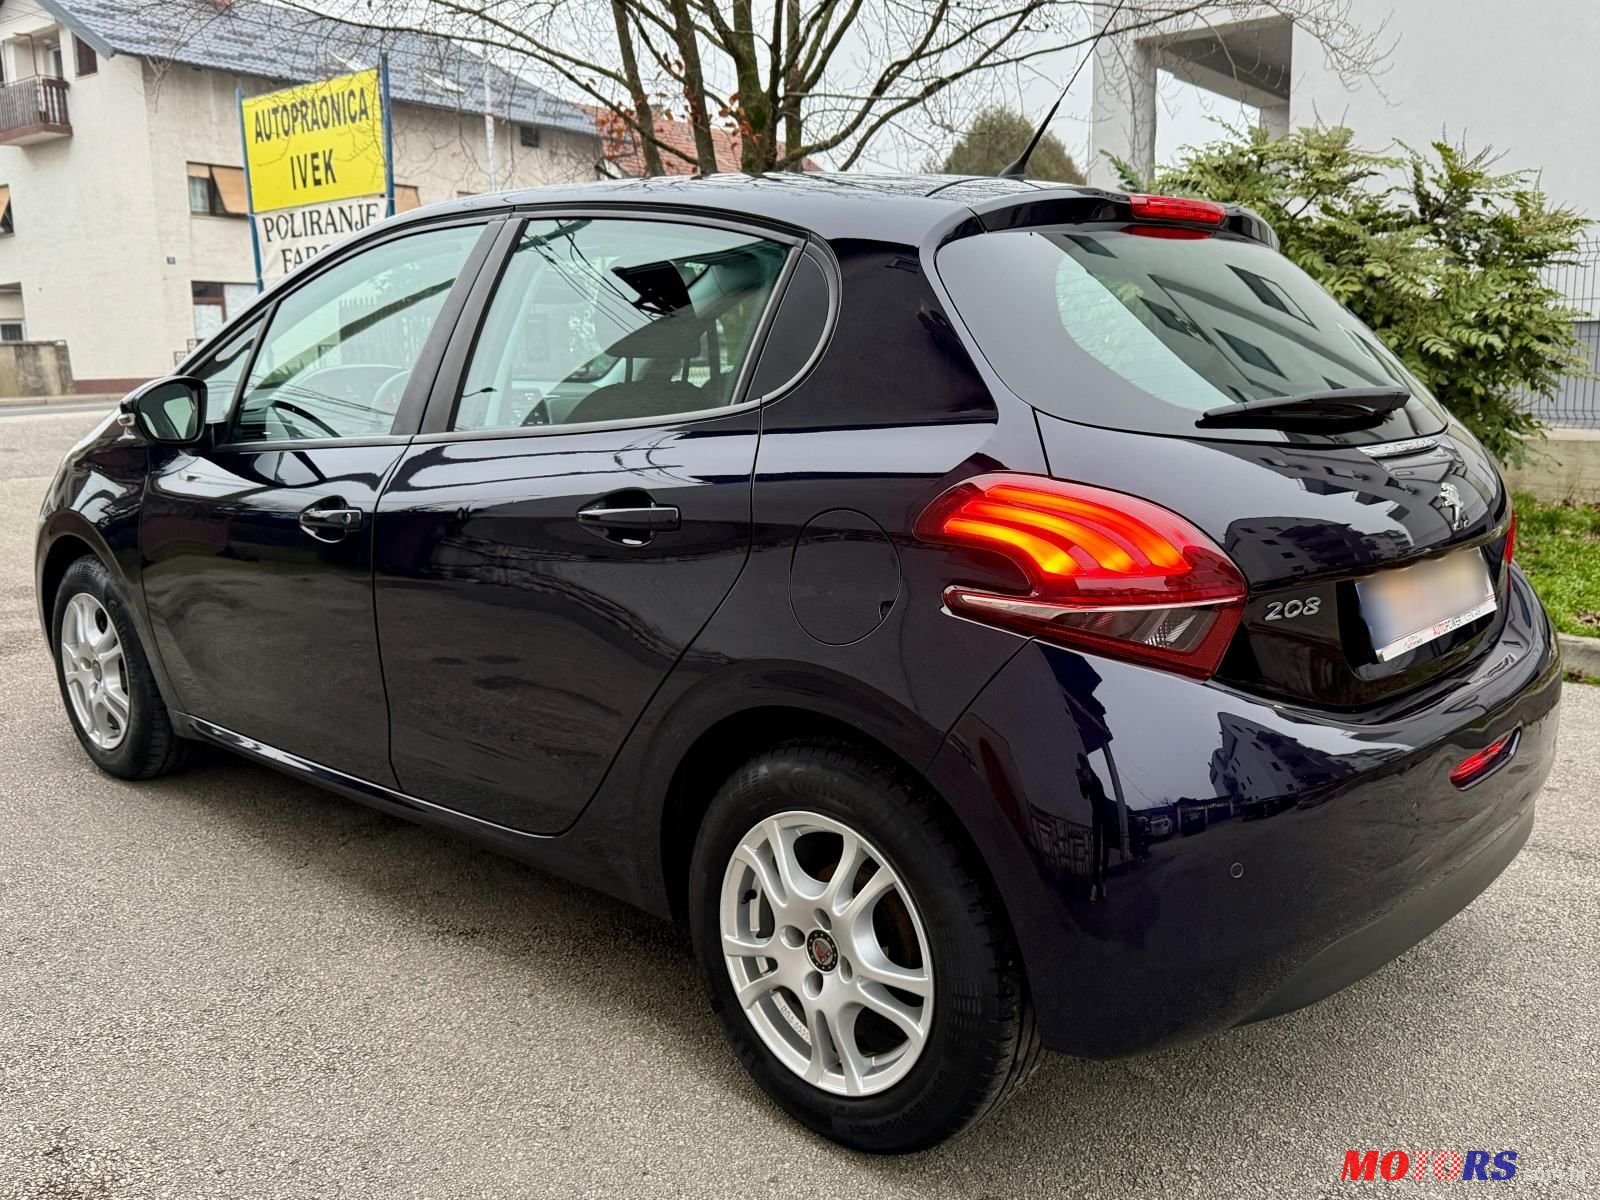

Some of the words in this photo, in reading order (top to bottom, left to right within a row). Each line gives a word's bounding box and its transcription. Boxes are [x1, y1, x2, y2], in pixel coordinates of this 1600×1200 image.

[255, 87, 369, 144] AUTOPRAONICA
[290, 149, 337, 190] IVEK
[262, 203, 379, 242] POLIRANJE
[1264, 596, 1321, 621] 208
